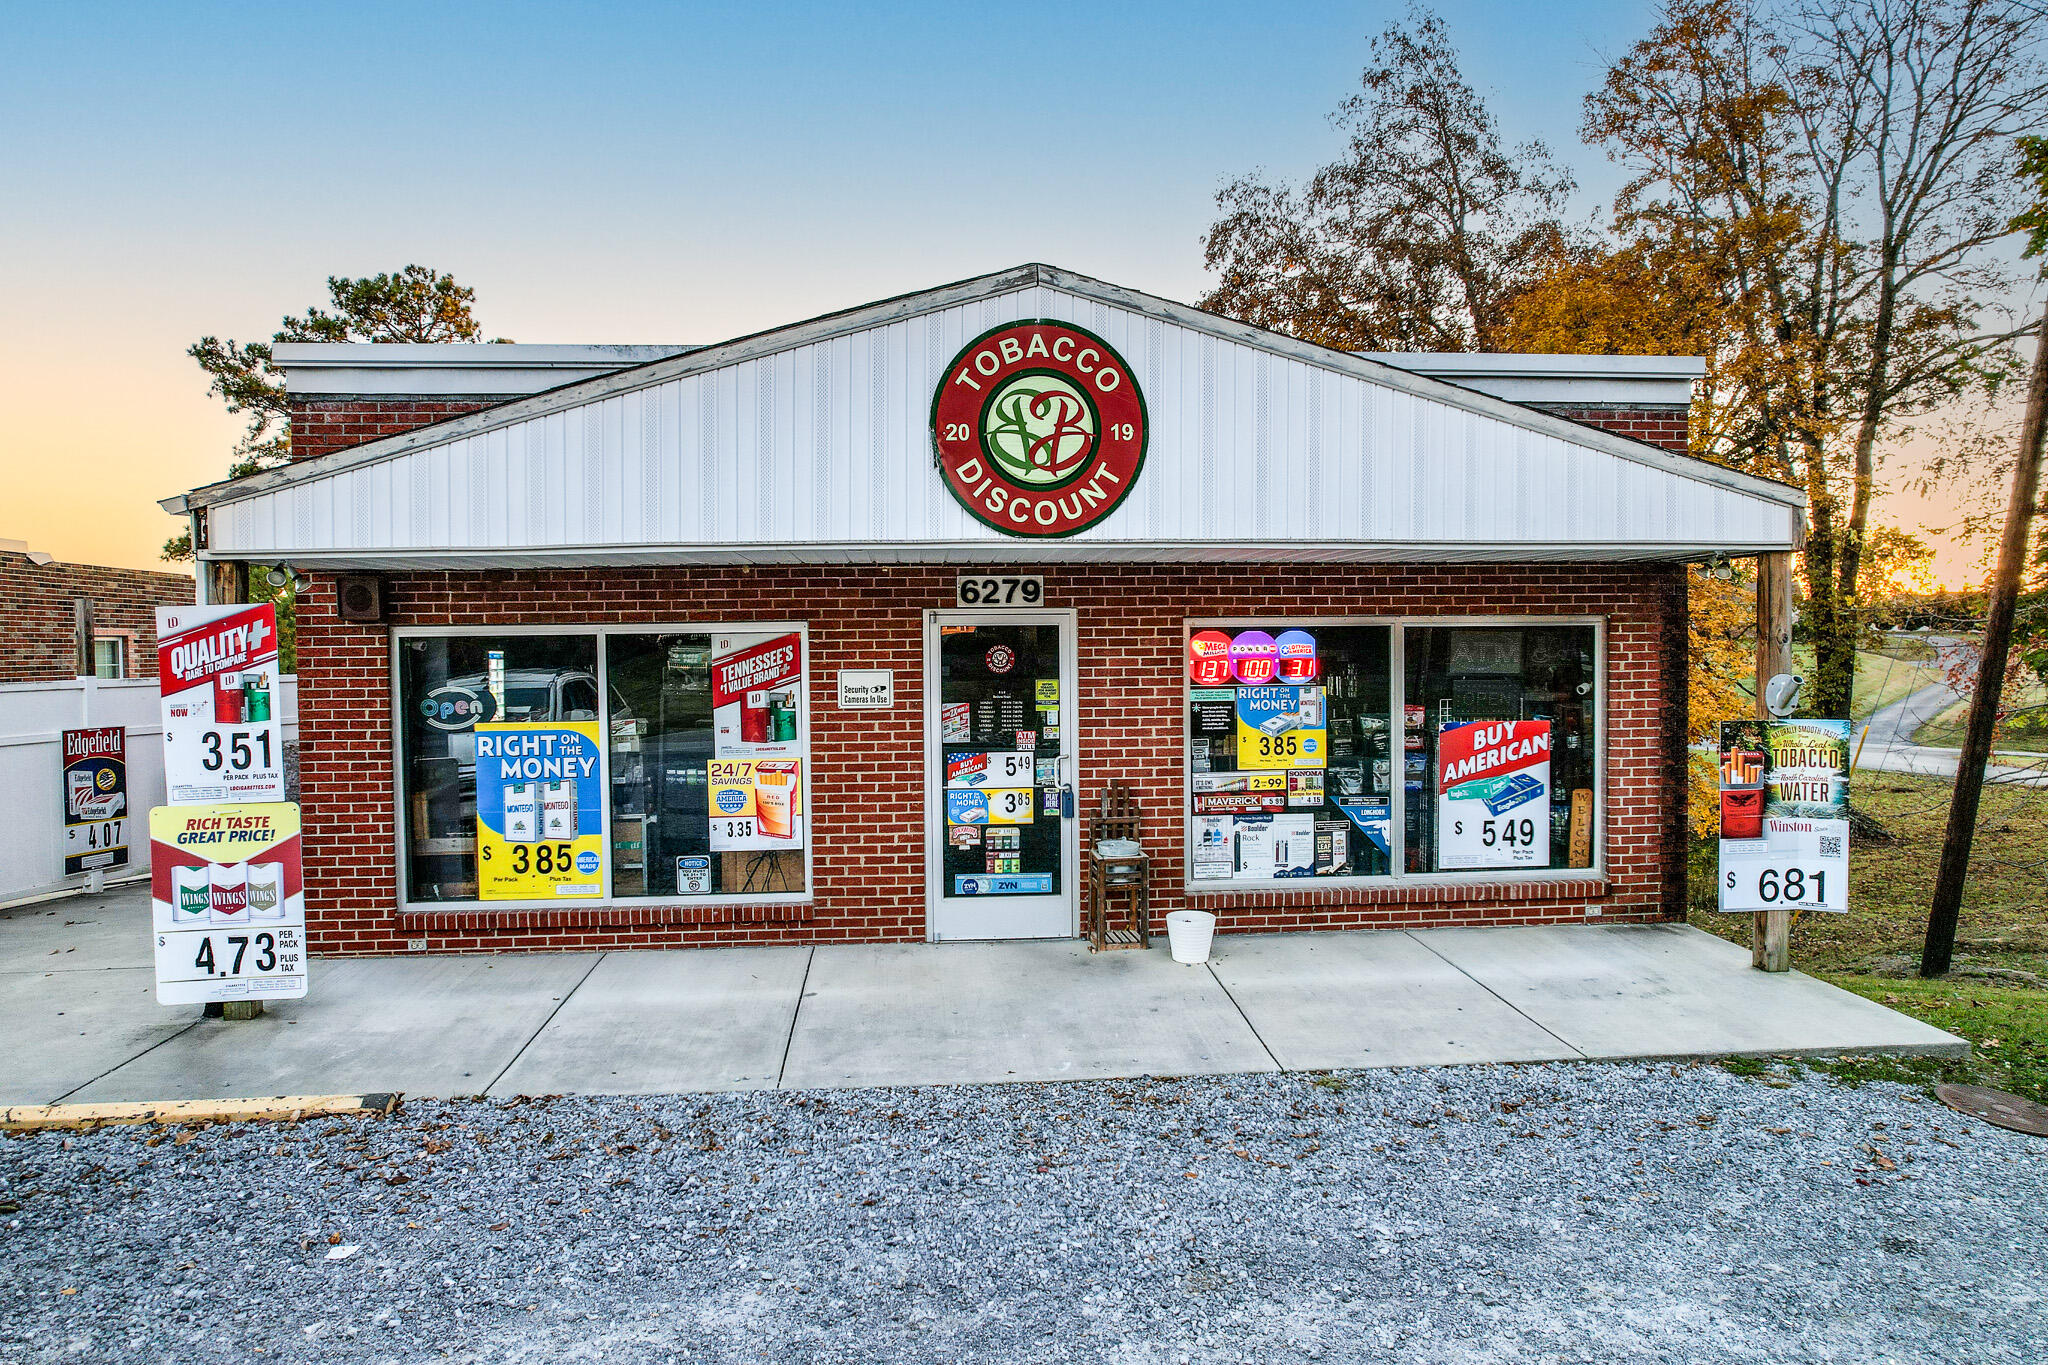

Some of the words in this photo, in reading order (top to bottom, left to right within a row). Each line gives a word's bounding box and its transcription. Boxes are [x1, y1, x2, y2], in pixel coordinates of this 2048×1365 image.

[955, 333, 1120, 392] TOBACCO
[945, 423, 970, 441] 20
[1110, 423, 1134, 441] 19
[955, 457, 1120, 526] DISCOUNT
[960, 579, 1040, 604] 6279
[988, 645, 1012, 655] TOBACCO
[185, 668, 204, 682] DARE
[204, 663, 215, 676] TO
[215, 651, 248, 672] COMPARE
[720, 644, 794, 683] TENNESSEE'S
[988, 663, 1013, 673] DISCOUNT
[1201, 660, 1229, 678] 137
[1243, 660, 1271, 677] 100
[728, 674, 753, 694] VALUE
[844, 685, 869, 696] Security
[844, 695, 868, 704] Cameras
[869, 695, 875, 704] In
[876, 695, 888, 703] Use
[1238, 688, 1278, 699] RIGHT
[1249, 699, 1297, 711] MONEY
[170, 709, 188, 718] NOW
[167, 732, 173, 742] $
[1016, 731, 1035, 739] ATM
[1473, 720, 1517, 751] BUY
[1771, 725, 1798, 741] NATURALLY
[1797, 724, 1821, 736] SMOOTH
[1822, 728, 1841, 741] TASTE
[67, 730, 122, 757] Edgefield
[477, 734, 557, 757] RIGHT
[560, 734, 580, 745] ON
[559, 746, 583, 756] THE
[1442, 732, 1549, 783] AMERICAN
[960, 759, 974, 769] BUY
[1773, 748, 1839, 769] TOBACCO
[500, 757, 596, 779] MONEY
[711, 762, 752, 777] 24/7
[951, 763, 983, 778] AMERICAN
[234, 773, 249, 781] PACK
[711, 777, 753, 786] SAVINGS
[1253, 779, 1260, 788] 2
[1780, 773, 1799, 782] North
[1798, 773, 1828, 782] Carolina
[950, 790, 973, 800] RIGHT
[1780, 782, 1829, 802] WATER
[544, 801, 569, 811] MONTEGO
[1045, 800, 1058, 808] HERE
[1207, 796, 1259, 806] MAVERICK
[1497, 799, 1517, 812] Eagle
[506, 803, 534, 813] MONTEGO
[186, 818, 221, 831] RICH
[226, 816, 270, 829] TASTE
[727, 821, 752, 838] 3.35
[1454, 820, 1463, 835] $
[1574, 792, 1589, 868] WELCOME
[1769, 820, 1812, 833] Winston
[88, 820, 121, 849] 4.07
[177, 831, 225, 845] GREAT
[228, 829, 276, 842] PRICE!
[1242, 834, 1260, 842] Rock
[482, 845, 491, 861] $
[1243, 861, 1248, 870] $
[963, 882, 976, 890] ZYN
[998, 882, 1018, 890] ZYN
[1726, 870, 1736, 891] $
[181, 892, 209, 906] WINGS
[212, 890, 246, 906] WINGS
[248, 890, 276, 903] WINGS
[279, 930, 293, 939] PER
[279, 940, 299, 948] PACK
[159, 936, 166, 947] $
[195, 932, 277, 977] 4.73
[280, 954, 299, 962] PLUS
[280, 964, 295, 972] TAX
